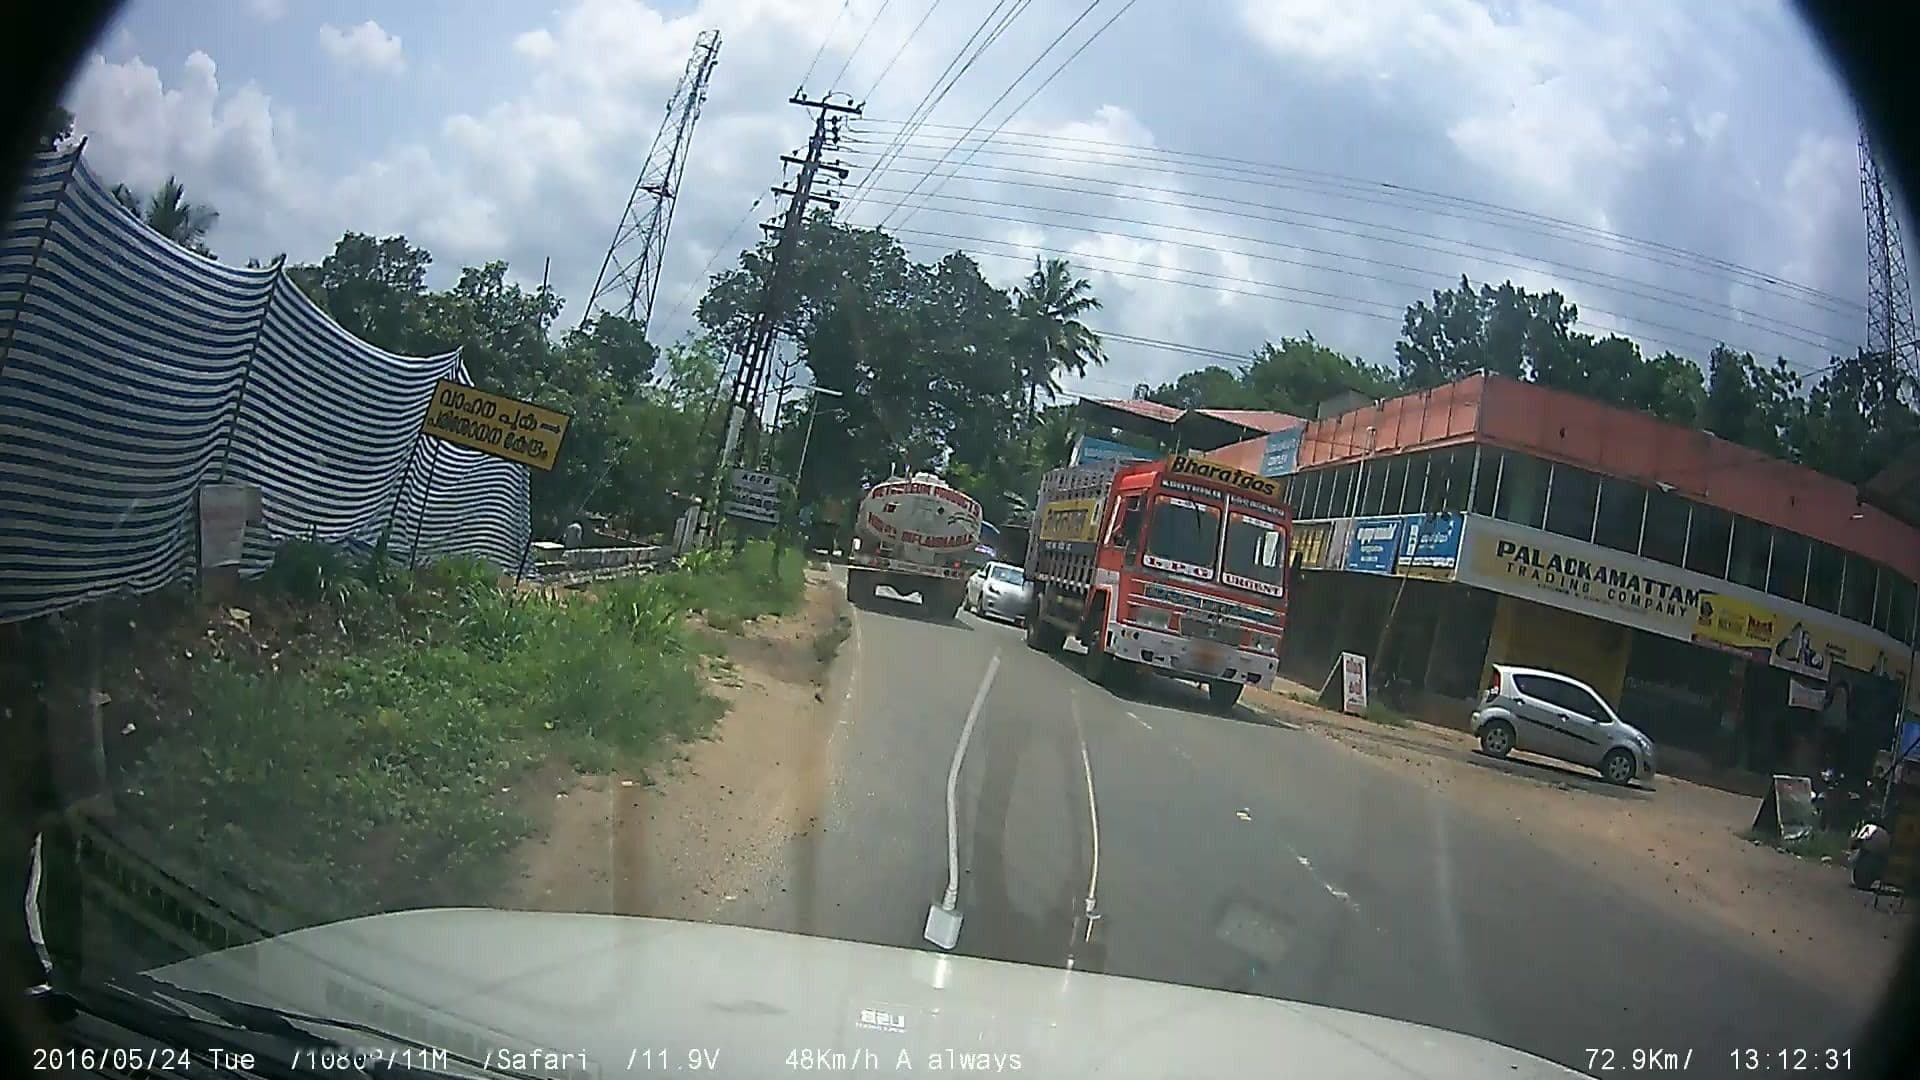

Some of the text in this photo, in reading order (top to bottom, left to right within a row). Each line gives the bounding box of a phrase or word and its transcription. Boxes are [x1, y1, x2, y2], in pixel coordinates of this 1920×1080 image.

[1496, 540, 1700, 608] PALACKAMATTAM
[1506, 562, 1591, 594] TRADING
[1607, 588, 1688, 617] COMPANY
